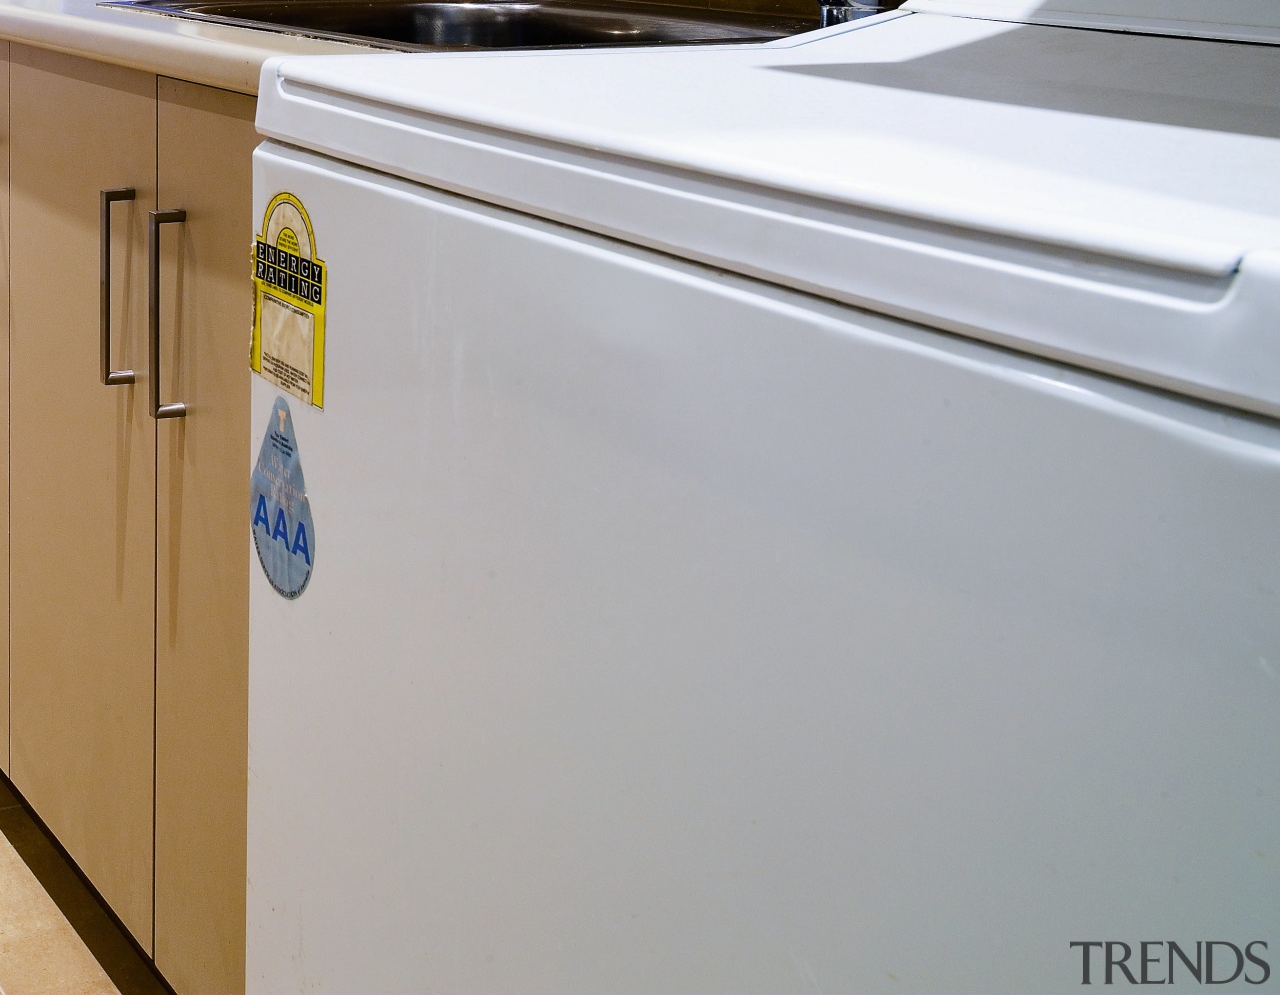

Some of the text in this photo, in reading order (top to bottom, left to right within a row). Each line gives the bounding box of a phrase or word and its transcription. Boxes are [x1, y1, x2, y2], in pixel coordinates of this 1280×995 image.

[257, 262, 320, 301] RATING
[258, 243, 320, 282] ENERGY
[253, 493, 311, 566] AAA
